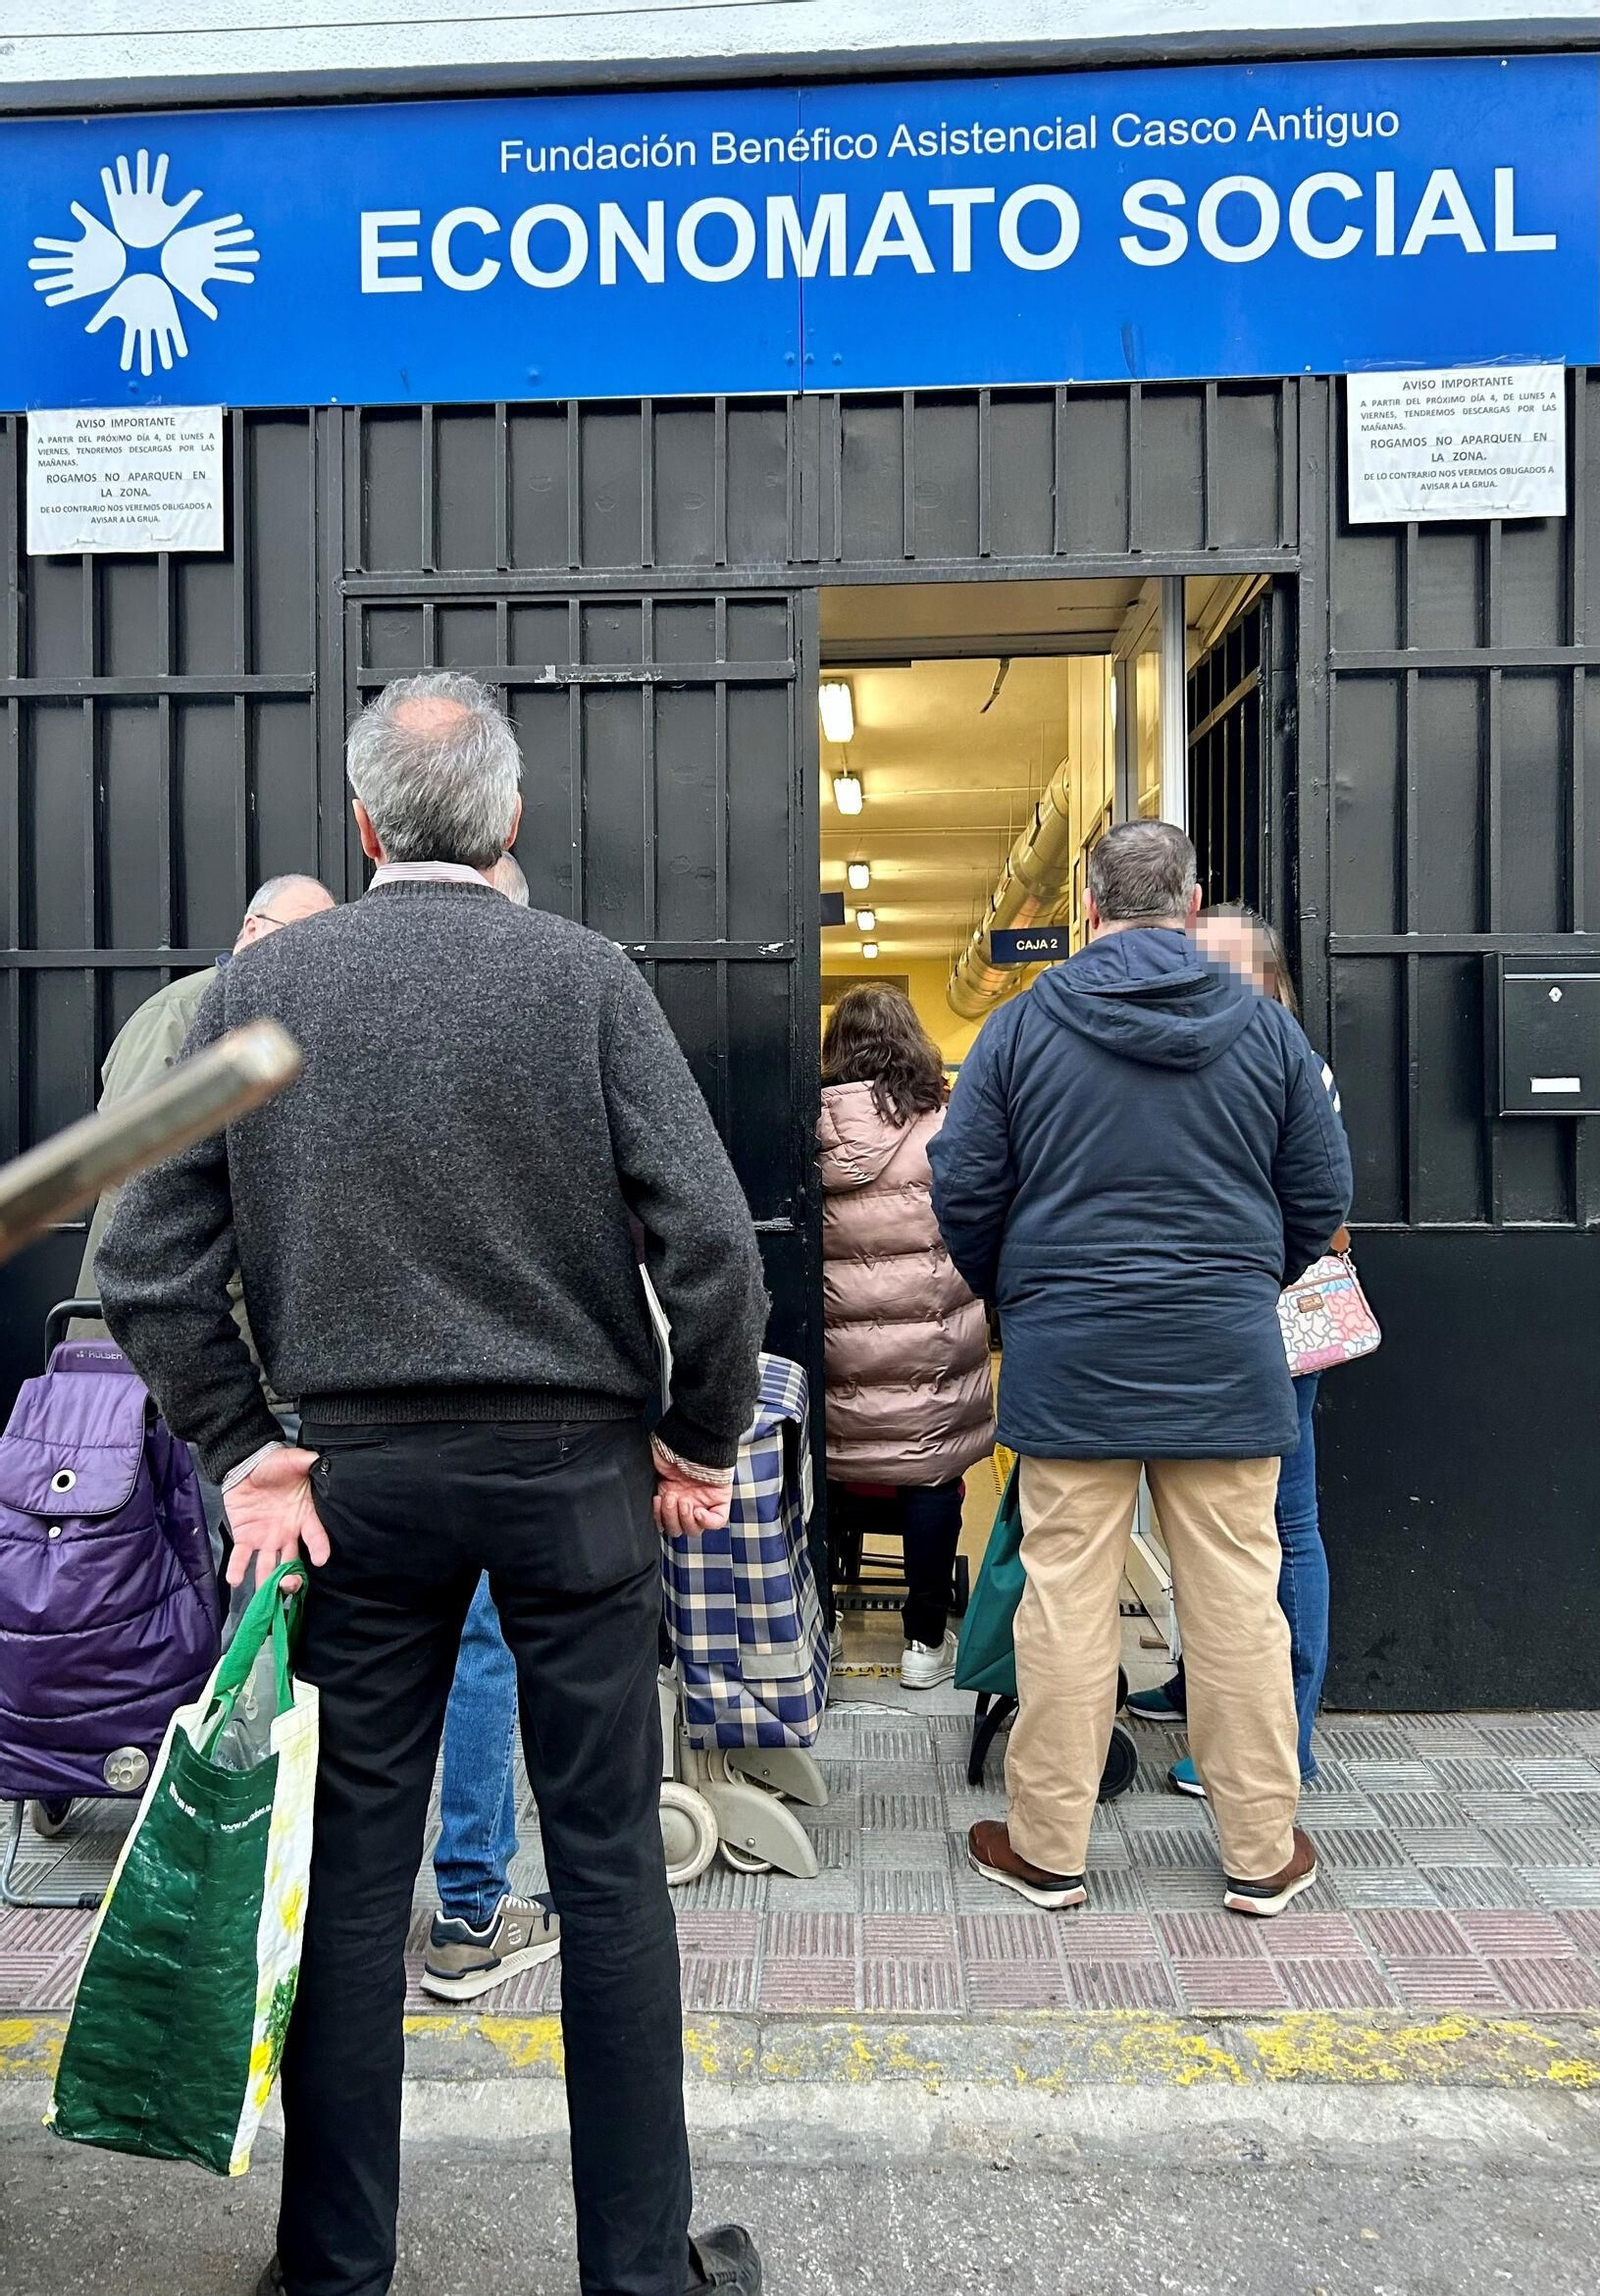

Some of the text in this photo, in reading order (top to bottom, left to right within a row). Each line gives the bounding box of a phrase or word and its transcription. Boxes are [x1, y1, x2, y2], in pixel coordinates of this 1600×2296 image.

[500, 104, 1400, 173] Fundación Benéfico Asistencial Casco Antiguo
[360, 166, 1557, 294] ECONOMATO SOCIAL
[1402, 376, 1514, 391] AVISO IMPORTANTE
[1360, 400, 1367, 408] A
[1371, 398, 1401, 407] PARTIR
[1406, 397, 1421, 406] DEL
[1470, 393, 1485, 403] DÍA
[1503, 393, 1515, 401] DE
[1519, 392, 1545, 401] LUNES
[1549, 391, 1556, 399] A
[1404, 408, 1456, 418] TENDREMOS
[1462, 405, 1510, 415] DESCARGAS
[1517, 404, 1535, 413] POR
[1542, 404, 1557, 412] LAS
[75, 417, 176, 428] AVISO IMPORTANTE
[48, 436, 74, 444] PARTIR
[78, 435, 92, 443] DEL
[136, 432, 150, 442] DÍA
[165, 433, 176, 441] DE
[180, 432, 204, 441] LUNES
[1370, 432, 1547, 449] ROGAMOS NO APARQUEN EN
[76, 446, 123, 455] TENDREMOS
[129, 445, 173, 454] DESCARGAS
[179, 444, 194, 452] POR
[201, 444, 215, 452] LAS
[1431, 452, 1444, 463] LA
[46, 470, 206, 484] ROGAMOS NO APARQUEN EN
[1364, 466, 1555, 481] DE LO CONTRARIO NOS VEREMOS OBLIGADOS A
[1420, 482, 1450, 491] AVISAR
[1451, 482, 1458, 490] A
[1459, 481, 1470, 489] LA
[101, 488, 113, 498] LA
[40, 506, 50, 514] DE
[51, 505, 62, 513] LO
[62, 504, 106, 513] CONTRARIO
[107, 504, 124, 512] NOS
[125, 503, 161, 512] VEREMOS
[162, 502, 205, 511] OBLIGADOS
[90, 516, 118, 524] AVISAR
[126, 515, 136, 523] LA
[1016, 938, 1058, 951] CAJA 2
